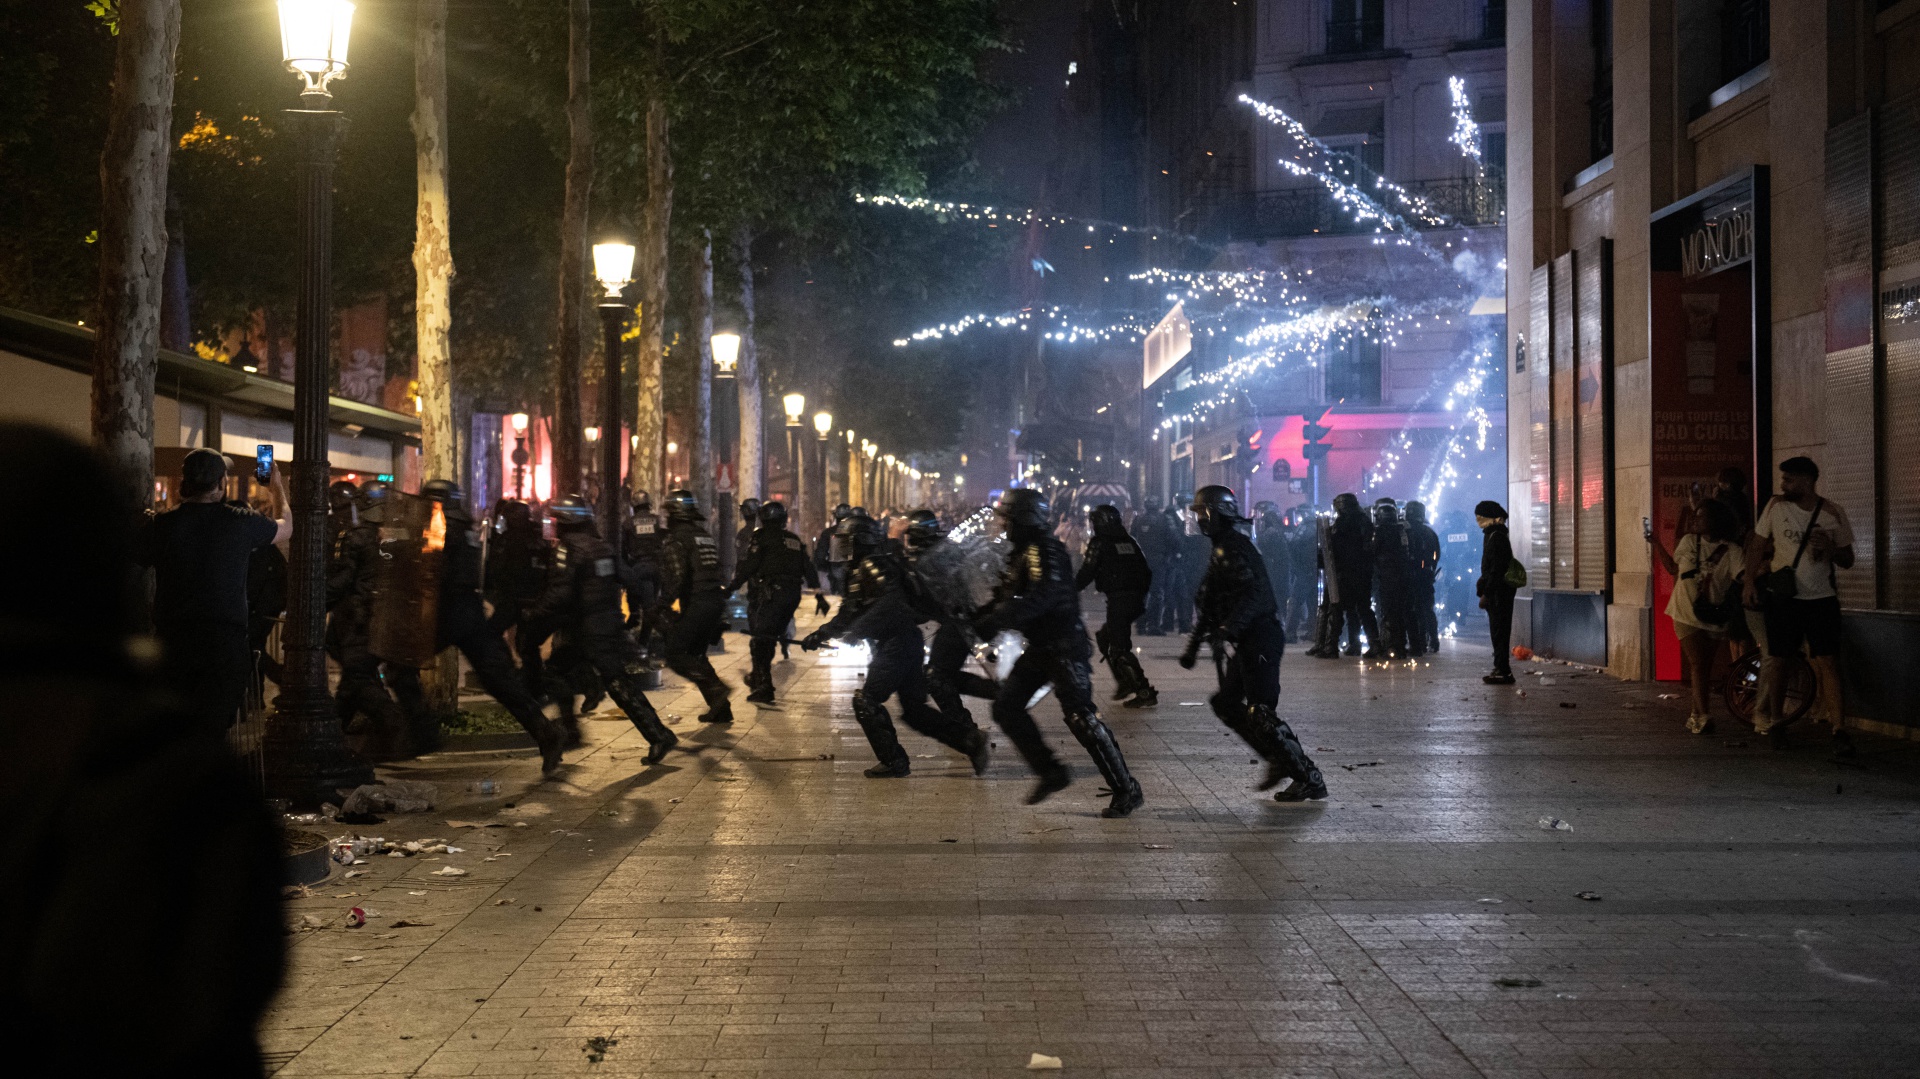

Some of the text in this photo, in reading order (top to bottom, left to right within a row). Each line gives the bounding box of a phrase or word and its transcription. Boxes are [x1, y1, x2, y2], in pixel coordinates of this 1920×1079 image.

[1654, 411, 1749, 422] POUR TOUTES LES
[1655, 424, 1750, 440] BAD CURLS
